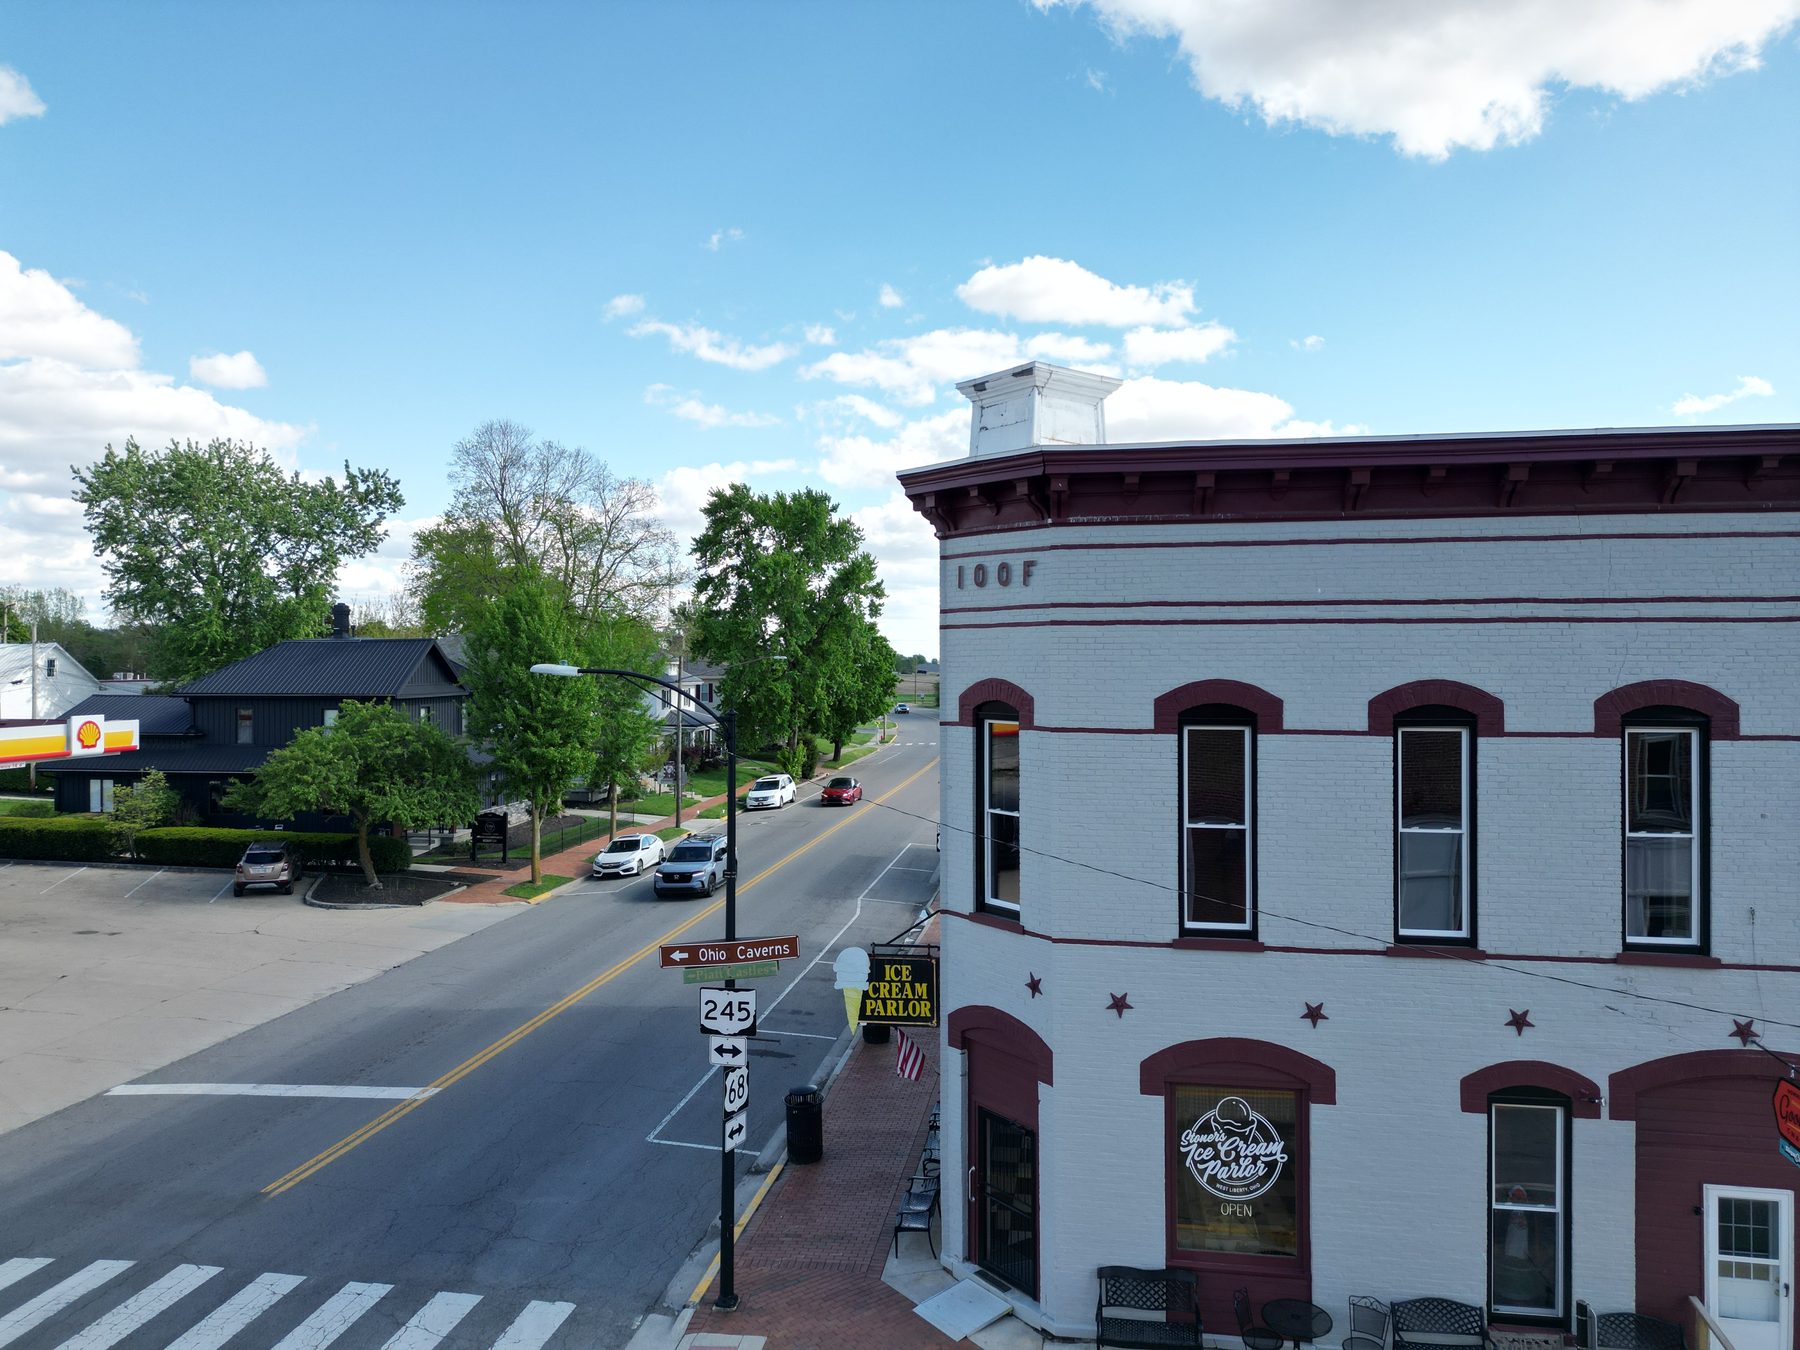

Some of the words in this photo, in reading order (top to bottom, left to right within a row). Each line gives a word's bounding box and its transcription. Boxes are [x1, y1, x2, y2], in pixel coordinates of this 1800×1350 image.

[699, 948, 727, 961] Ohio
[736, 944, 790, 959] Caverns
[884, 964, 912, 981] ICE
[868, 982, 928, 999] CREAM
[704, 999, 751, 1022] 245
[865, 999, 931, 1017] PARLOR
[728, 1074, 745, 1105] 68
[1181, 1129, 1227, 1146] Stoner's
[1180, 1143, 1215, 1167] Ice
[1217, 1137, 1288, 1162] Cream
[1197, 1156, 1268, 1182] Parlor
[1220, 1202, 1252, 1217] OPEN
